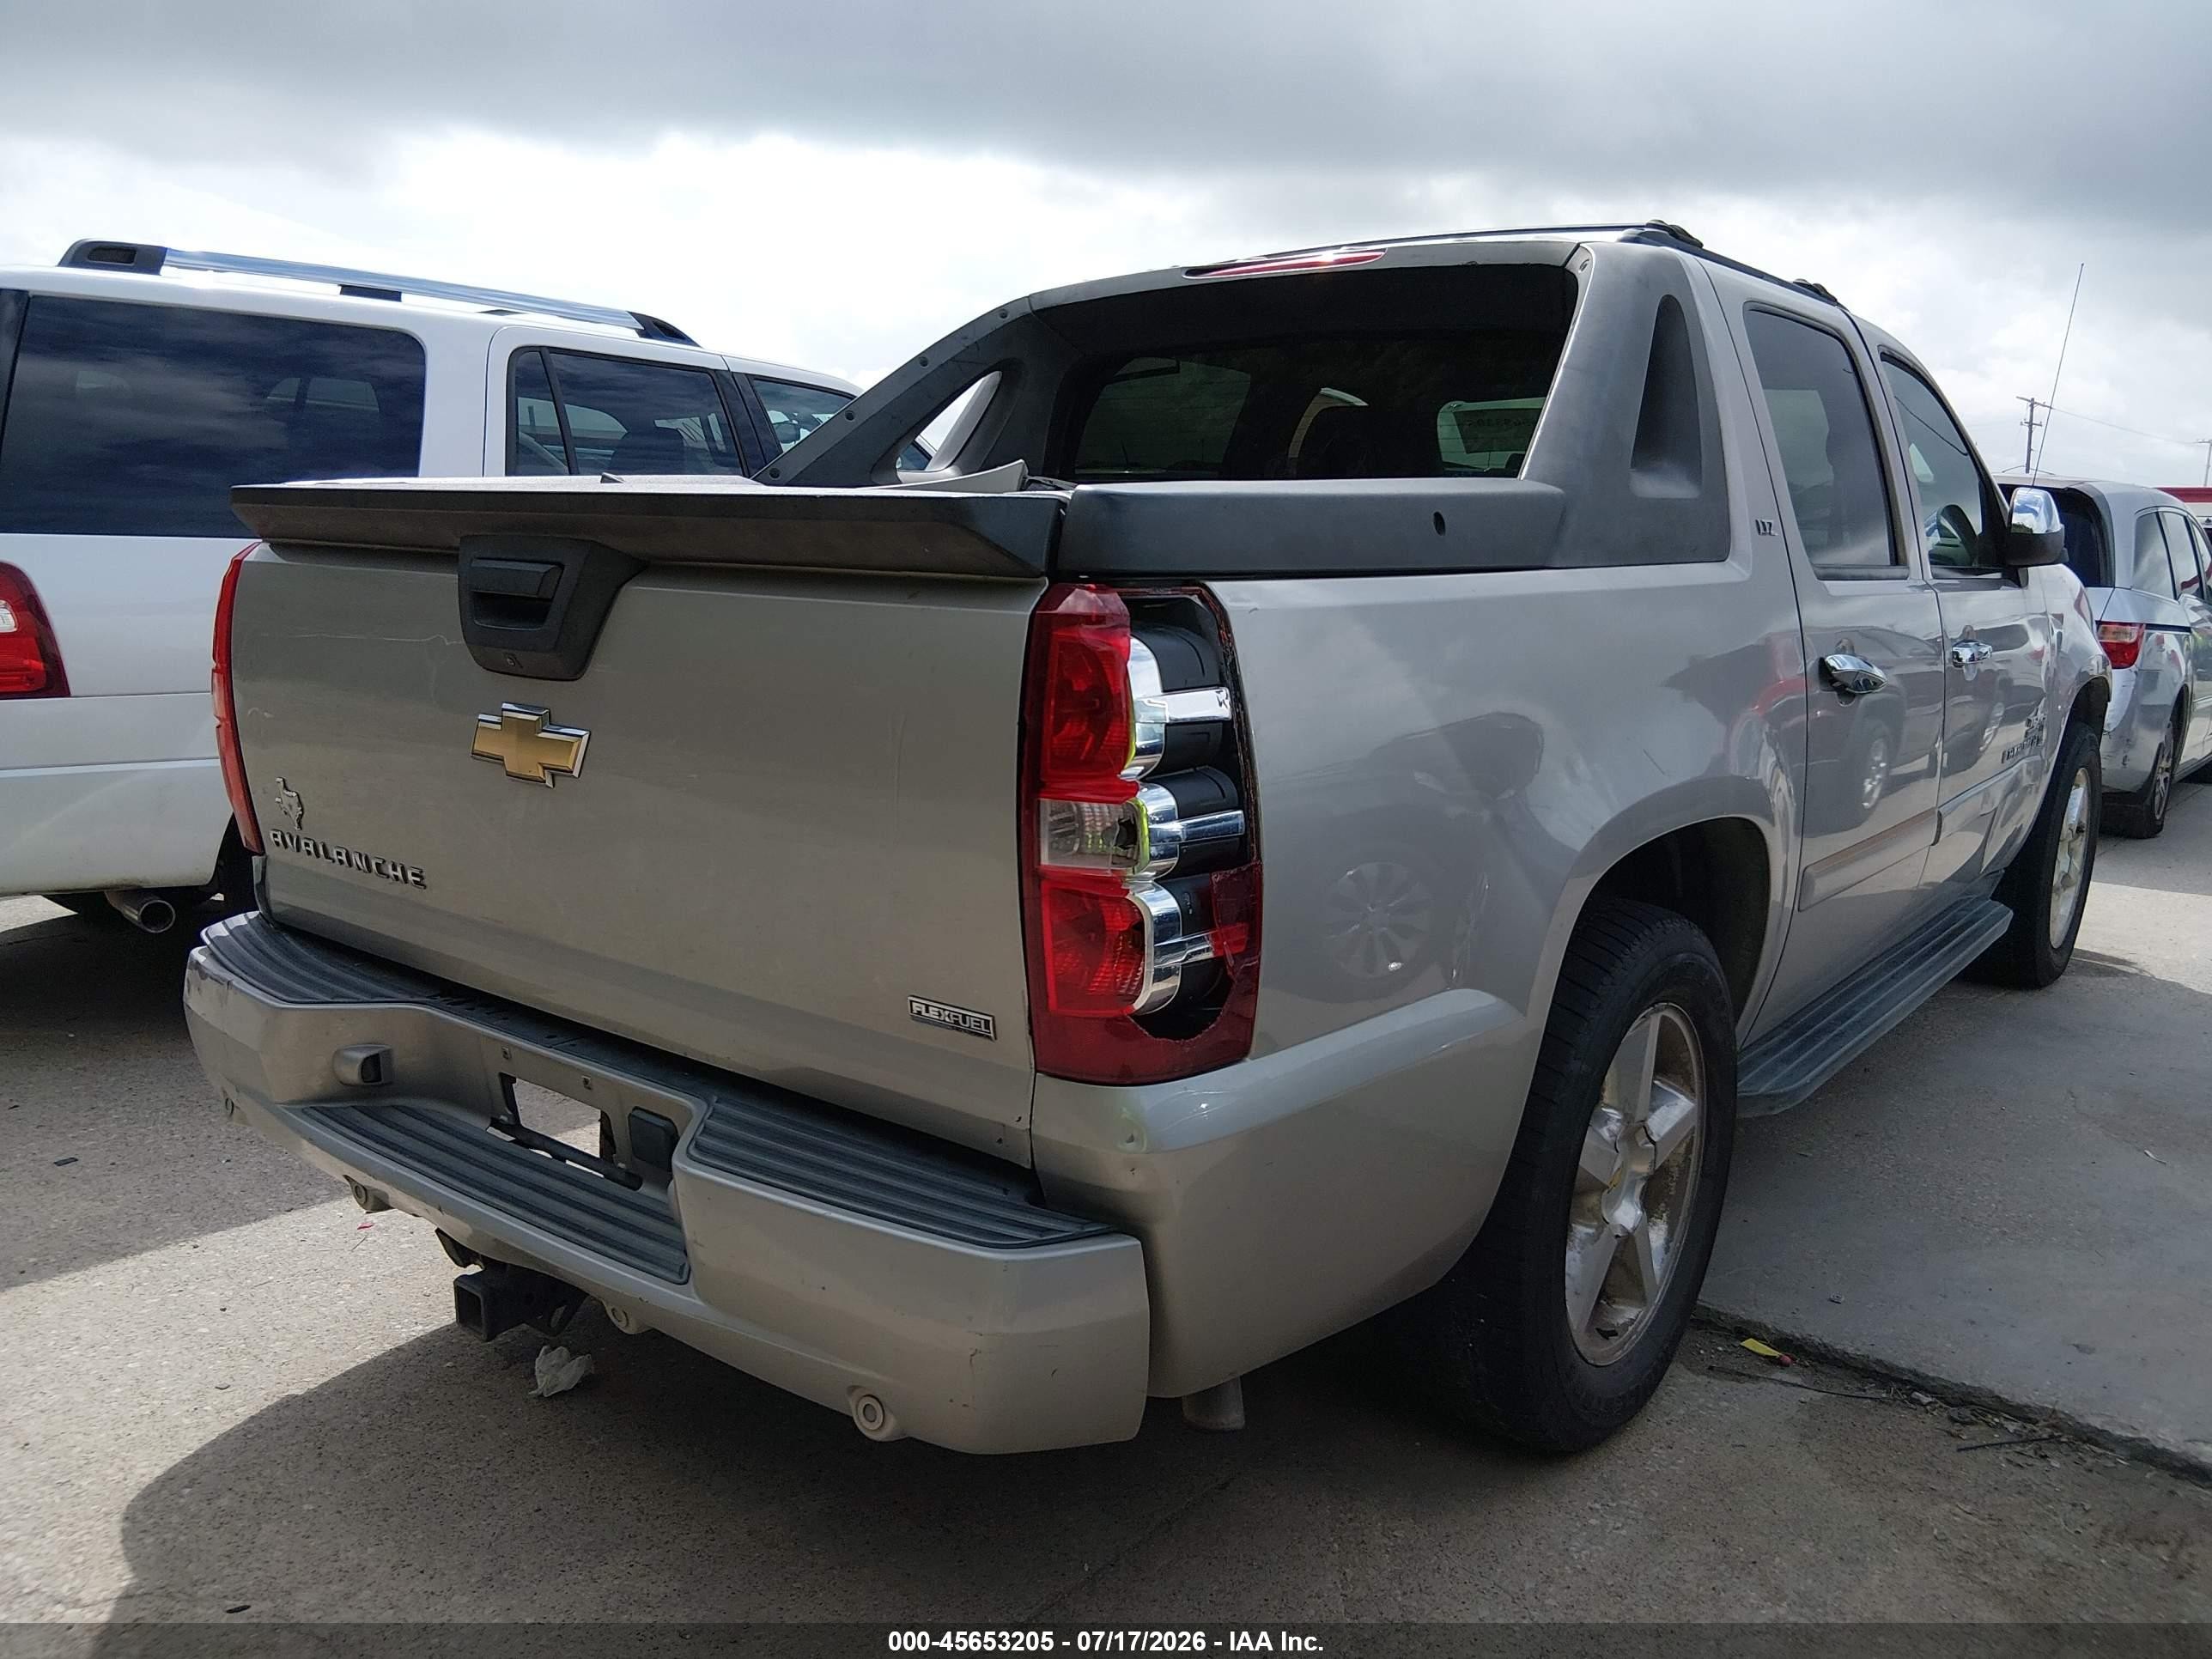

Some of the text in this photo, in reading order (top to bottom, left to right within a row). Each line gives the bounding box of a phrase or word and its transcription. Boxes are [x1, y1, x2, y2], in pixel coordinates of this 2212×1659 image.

[1755, 519, 1778, 537] LTZ
[270, 829, 427, 890] AVALANCHE
[911, 1001, 991, 1033] FLEXFUEL
